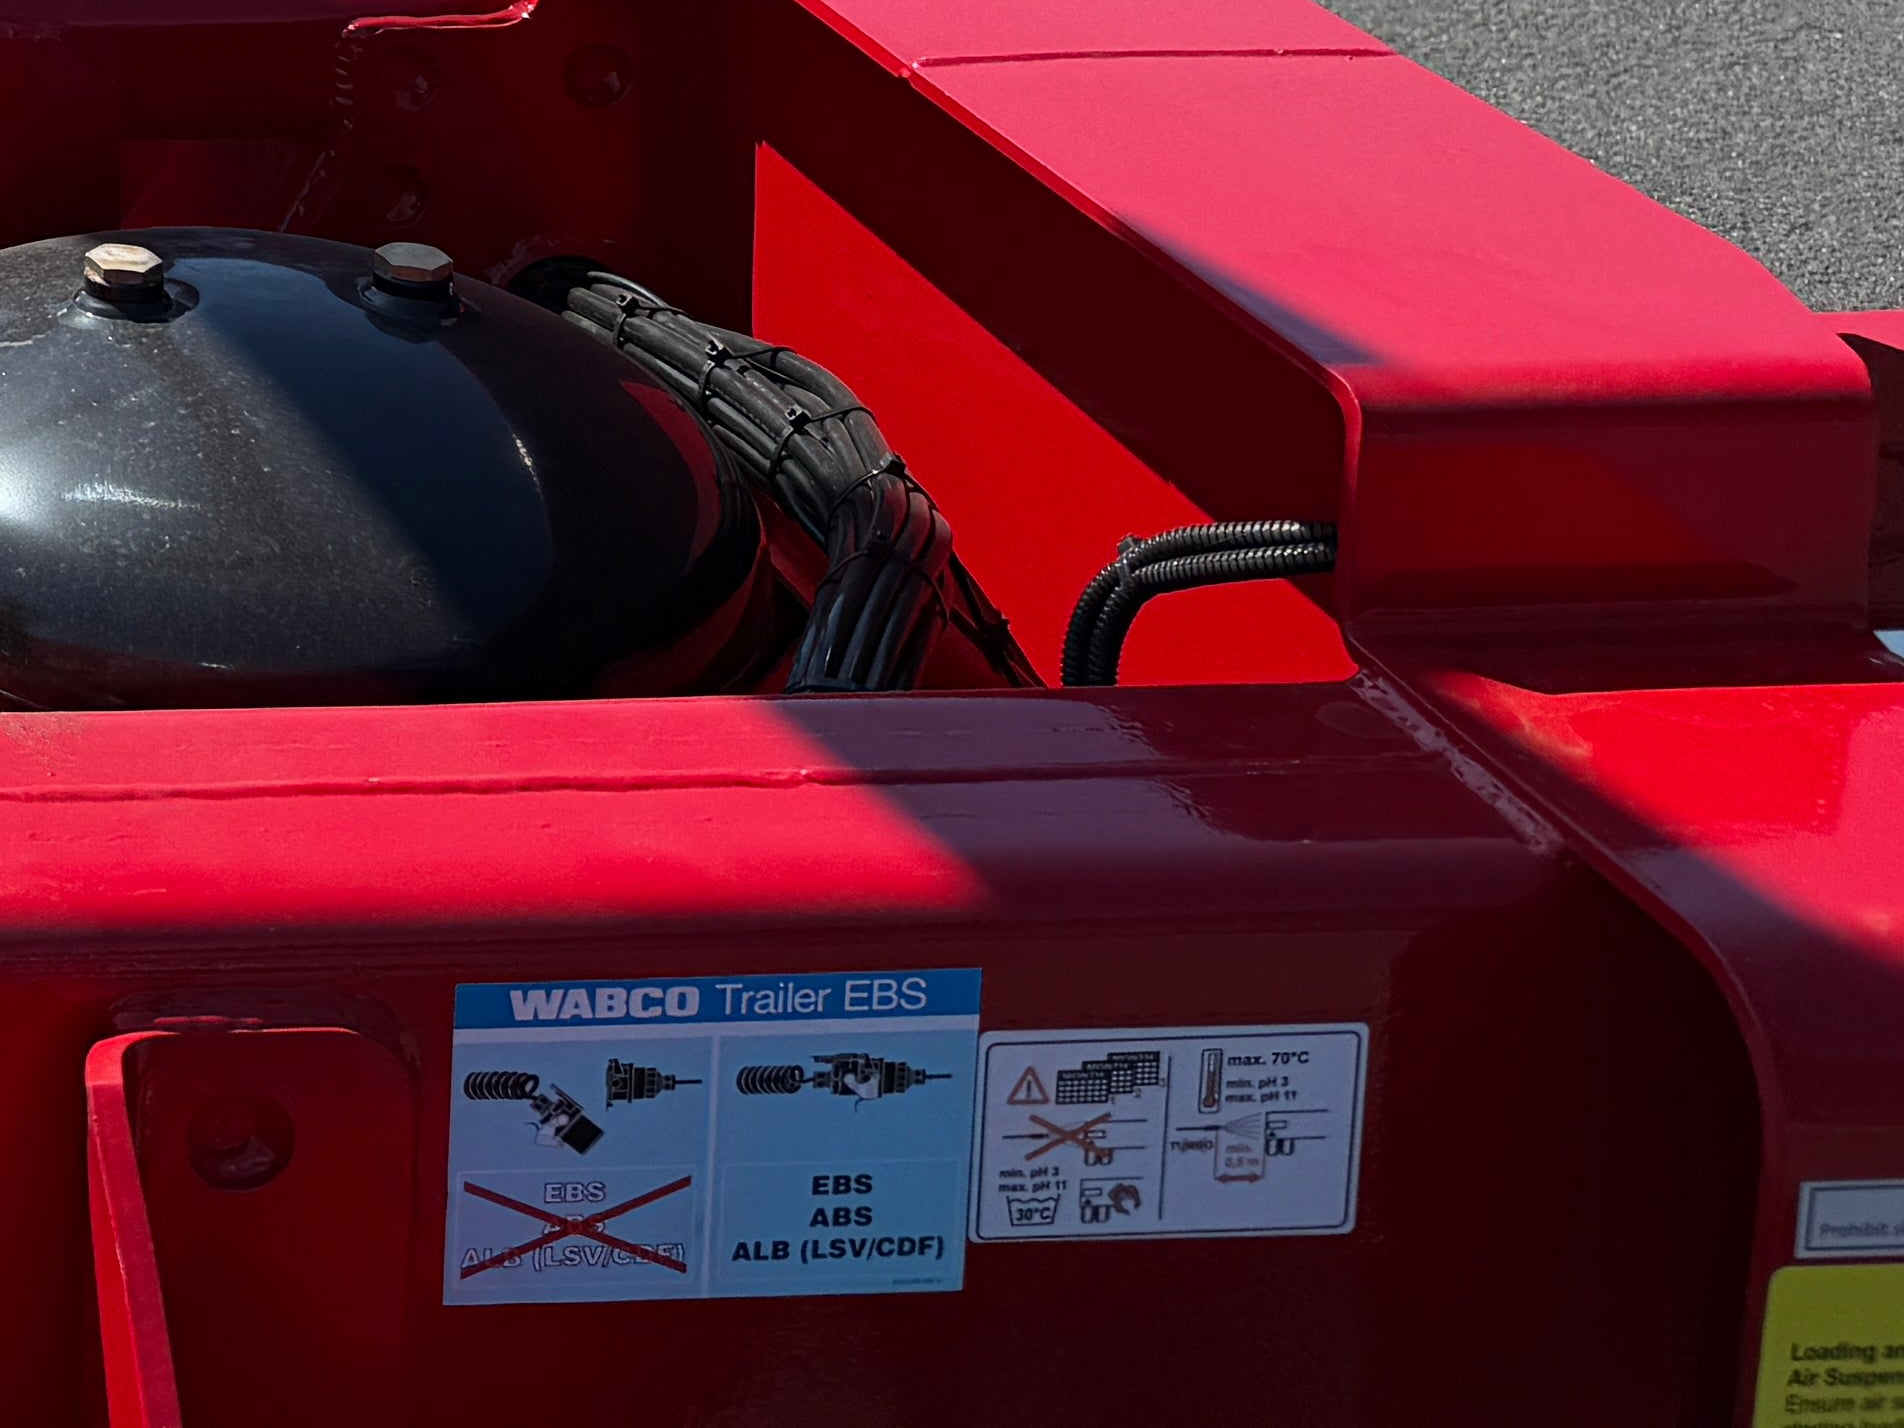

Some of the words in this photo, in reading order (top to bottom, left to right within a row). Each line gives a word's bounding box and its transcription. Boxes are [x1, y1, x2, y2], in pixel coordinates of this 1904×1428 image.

[510, 986, 700, 1021] WABCO
[716, 983, 832, 1015] Trailer
[844, 977, 928, 1011] EBS
[1227, 1055, 1266, 1066] max.
[543, 1182, 607, 1204] EBS
[811, 1174, 874, 1196] EBS
[809, 1206, 874, 1227] ABS
[731, 1239, 790, 1261] ALB
[800, 1235, 945, 1264] (LSV/CDF)
[1789, 1342, 1876, 1364] Loading
